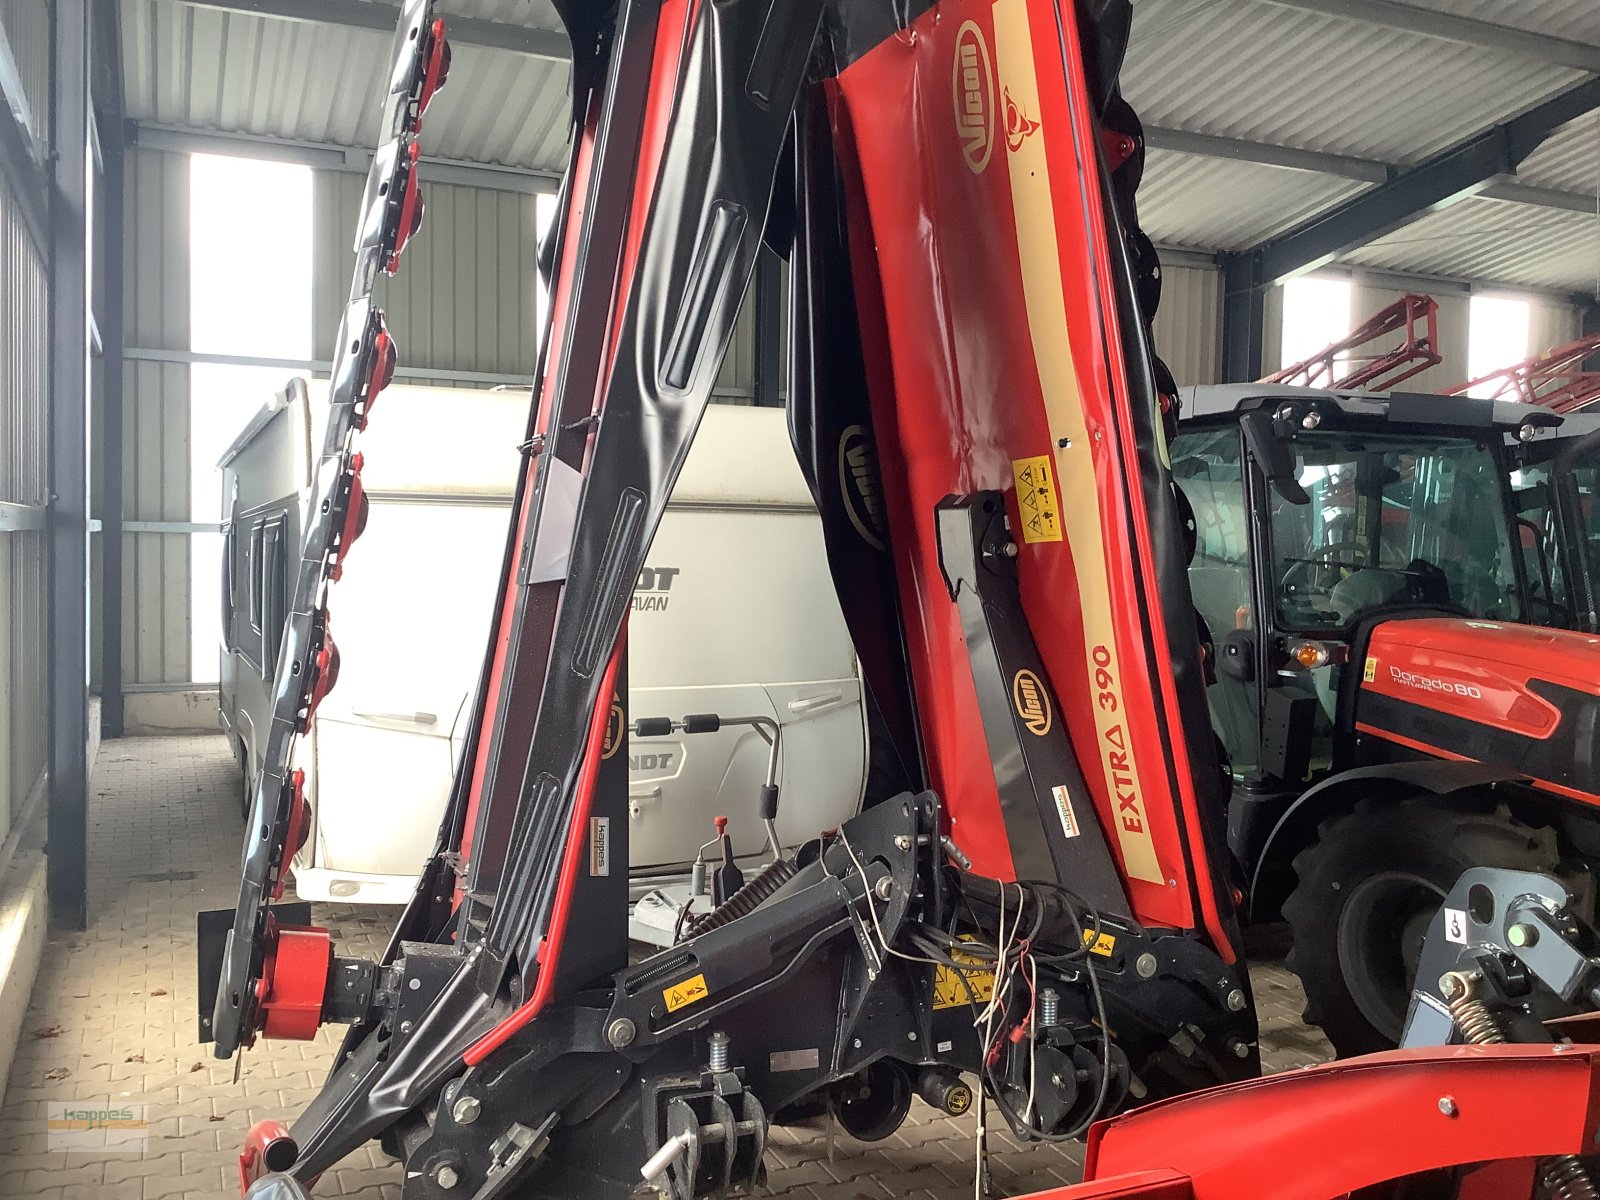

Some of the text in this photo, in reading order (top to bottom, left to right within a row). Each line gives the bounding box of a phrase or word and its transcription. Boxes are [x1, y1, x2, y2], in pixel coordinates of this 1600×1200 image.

[1018, 677, 1047, 731] Vicon
[1092, 645, 1144, 834] EXTRA 390
[593, 825, 606, 867] kappes
